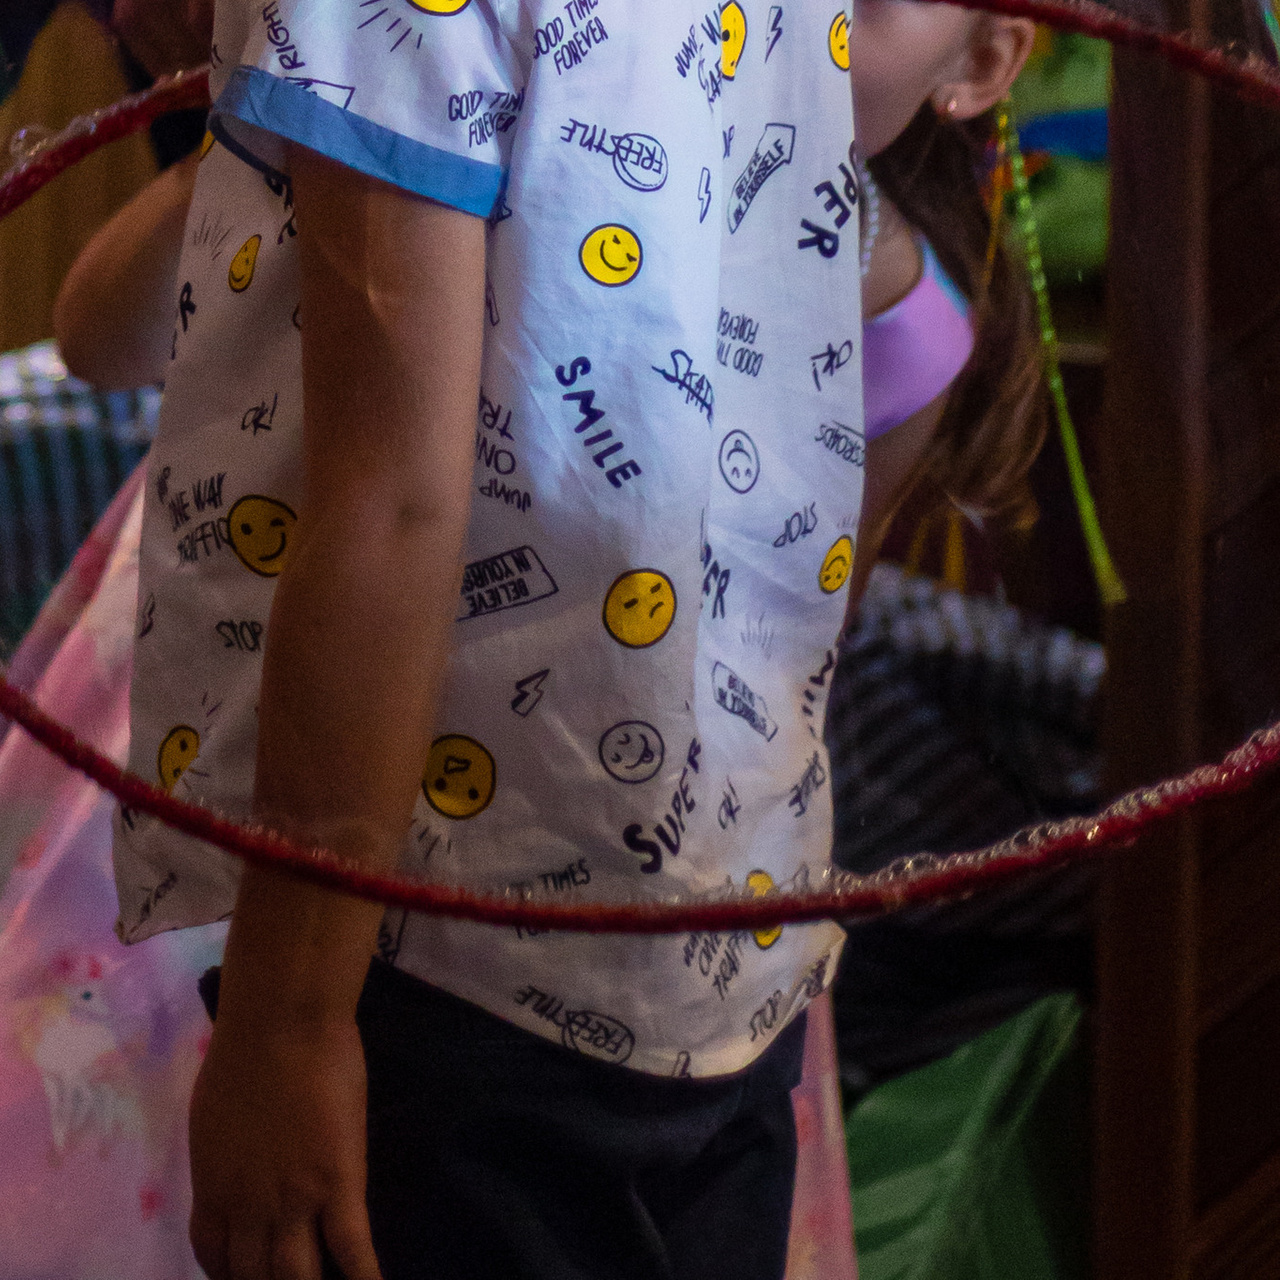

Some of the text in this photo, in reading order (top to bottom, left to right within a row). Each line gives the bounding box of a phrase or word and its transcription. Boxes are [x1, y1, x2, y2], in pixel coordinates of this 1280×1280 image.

[553, 15, 609, 76] FOREVER
[732, 347, 763, 378] GOOD
[555, 356, 642, 489] SMILE
[192, 472, 227, 513] WAY
[478, 478, 532, 513] JUMP
[512, 550, 531, 573] IN
[215, 619, 263, 652] STOP
[622, 737, 702, 875] SUPER
[538, 856, 591, 891] TIMES
